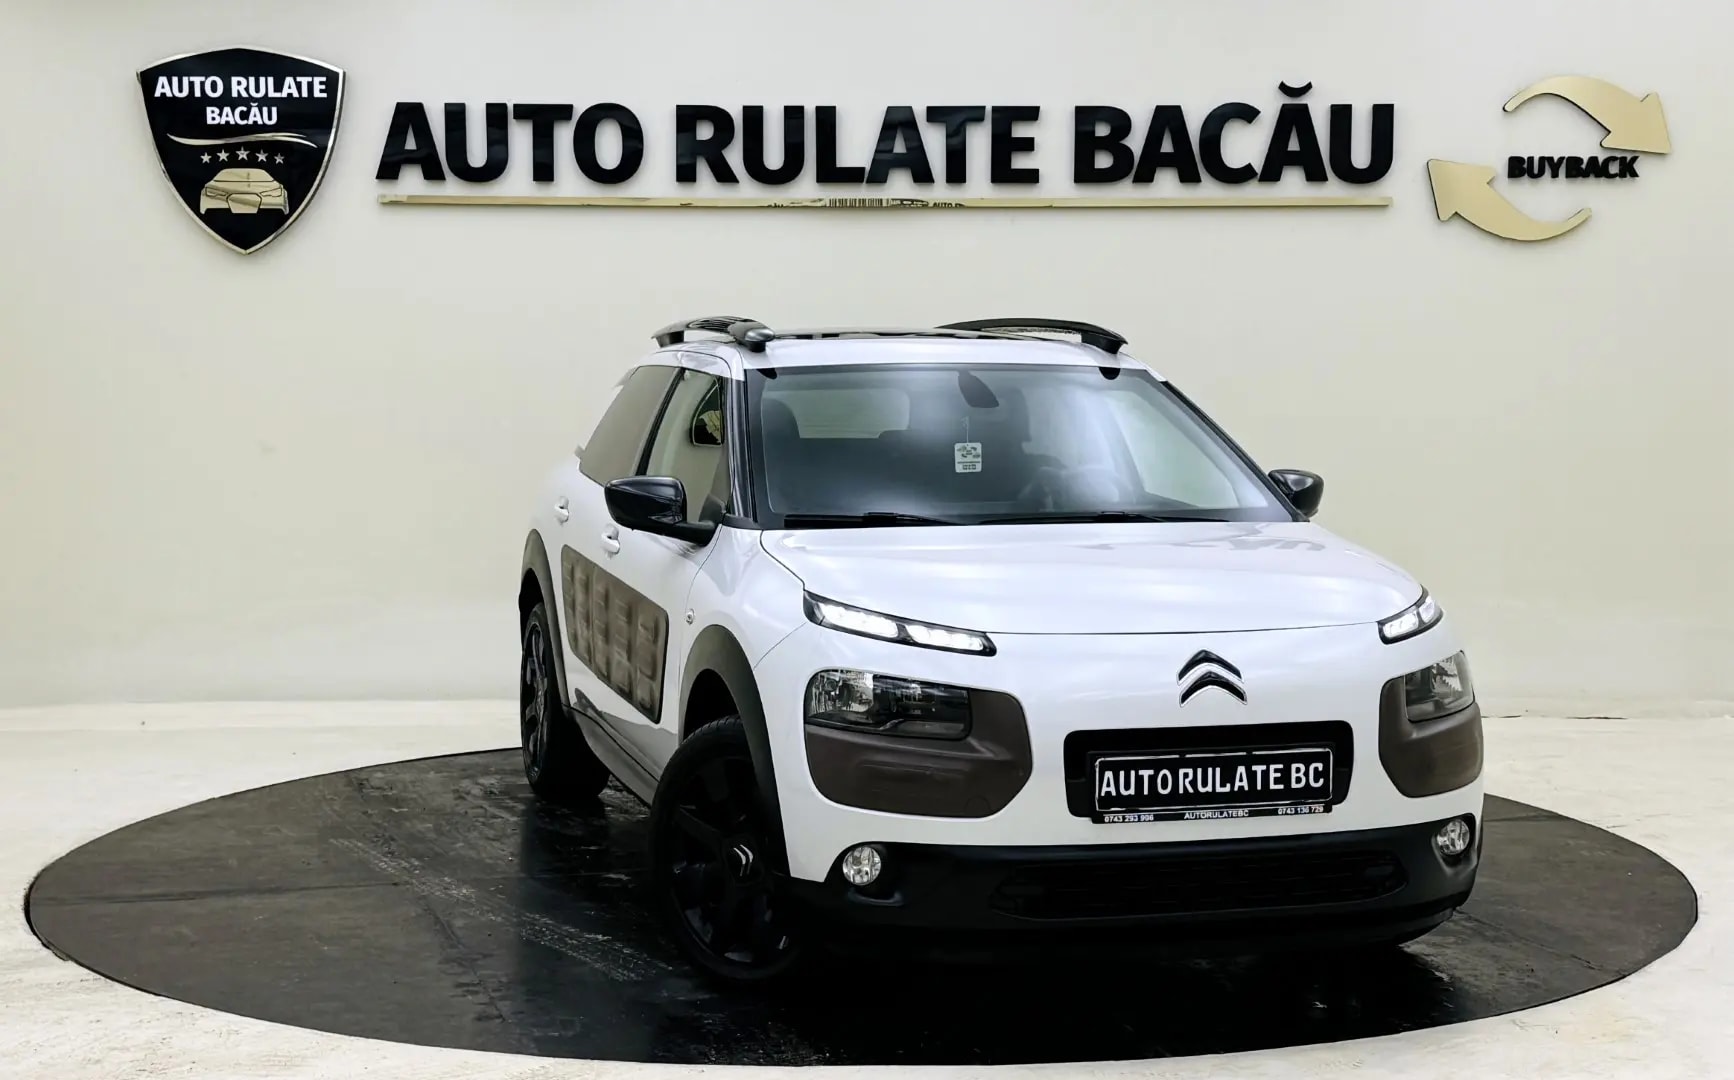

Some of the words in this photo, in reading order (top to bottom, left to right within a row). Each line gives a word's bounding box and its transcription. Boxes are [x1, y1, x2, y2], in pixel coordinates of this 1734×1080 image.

[154, 76, 224, 98] AUTO
[231, 76, 328, 98] RULATE
[206, 102, 278, 125] BACĂU
[375, 101, 645, 185] AUTO
[675, 104, 1041, 185] RULATE
[1073, 80, 1395, 185] BACĂU
[1507, 155, 1640, 179] BUYBACK
[1101, 769, 1173, 797] AUTO
[1178, 764, 1285, 795] RULATE
[1290, 762, 1325, 790] BC
[1184, 809, 1250, 820] AUTORULATEBC
